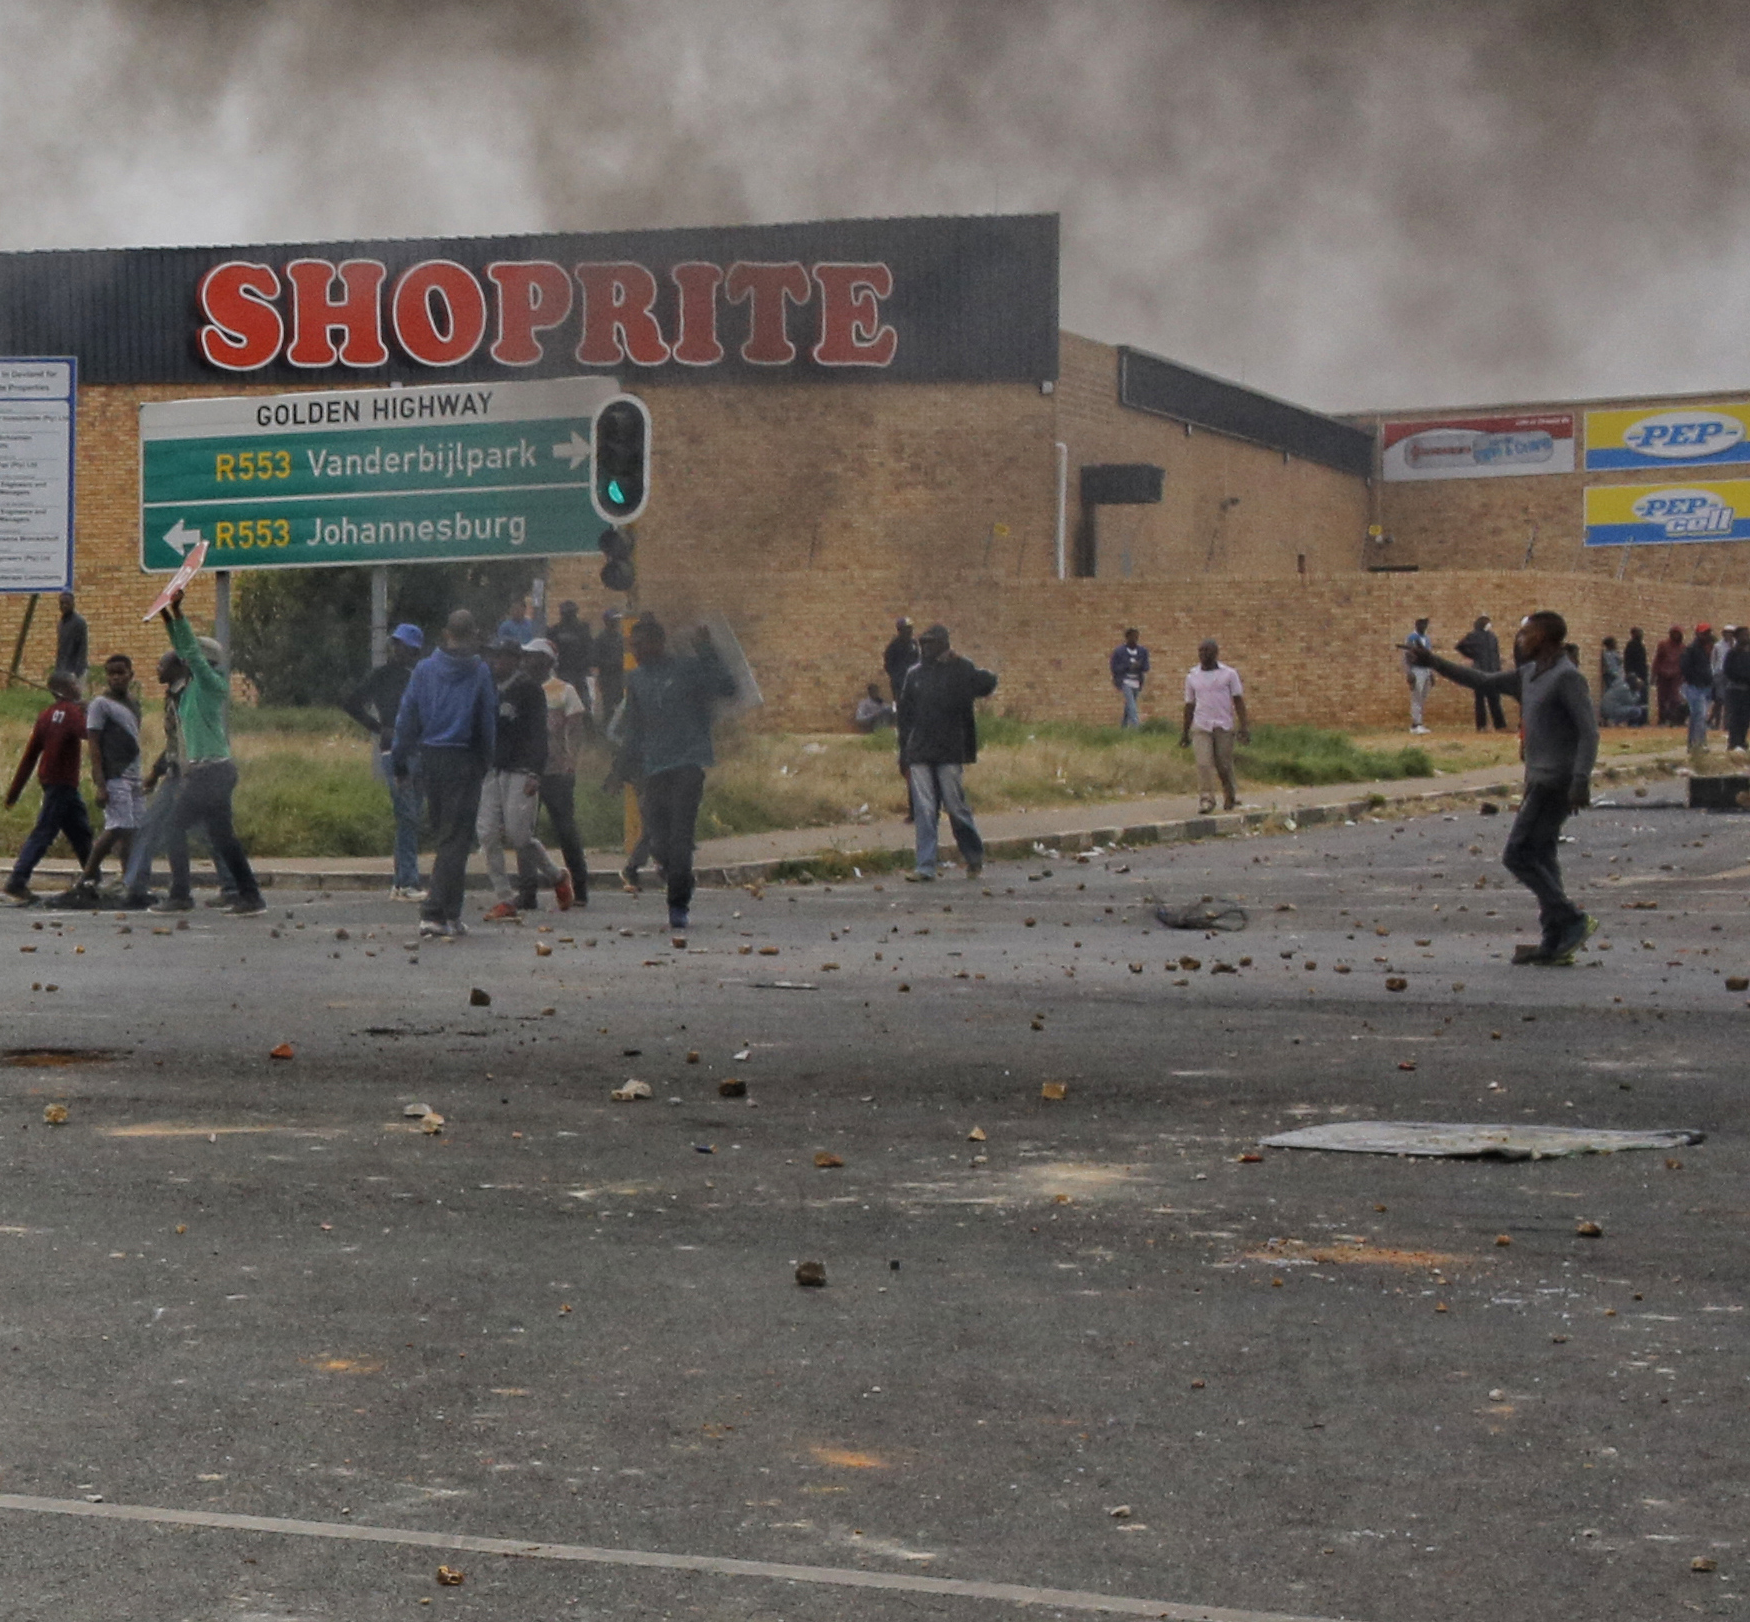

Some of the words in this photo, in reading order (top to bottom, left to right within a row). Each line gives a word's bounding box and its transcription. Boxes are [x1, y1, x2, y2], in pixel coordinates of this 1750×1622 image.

[198, 258, 898, 370] SHOPRITE
[256, 400, 361, 428] GOLDEN
[372, 392, 493, 421] HIGHWAY
[1637, 421, 1724, 448] PEP
[215, 449, 291, 483] R553
[306, 440, 537, 481] Vanderbijlpark
[1643, 497, 1709, 516] PEP
[1666, 507, 1733, 534] cell
[214, 518, 291, 551] R553
[304, 511, 527, 548] Johannesburg
